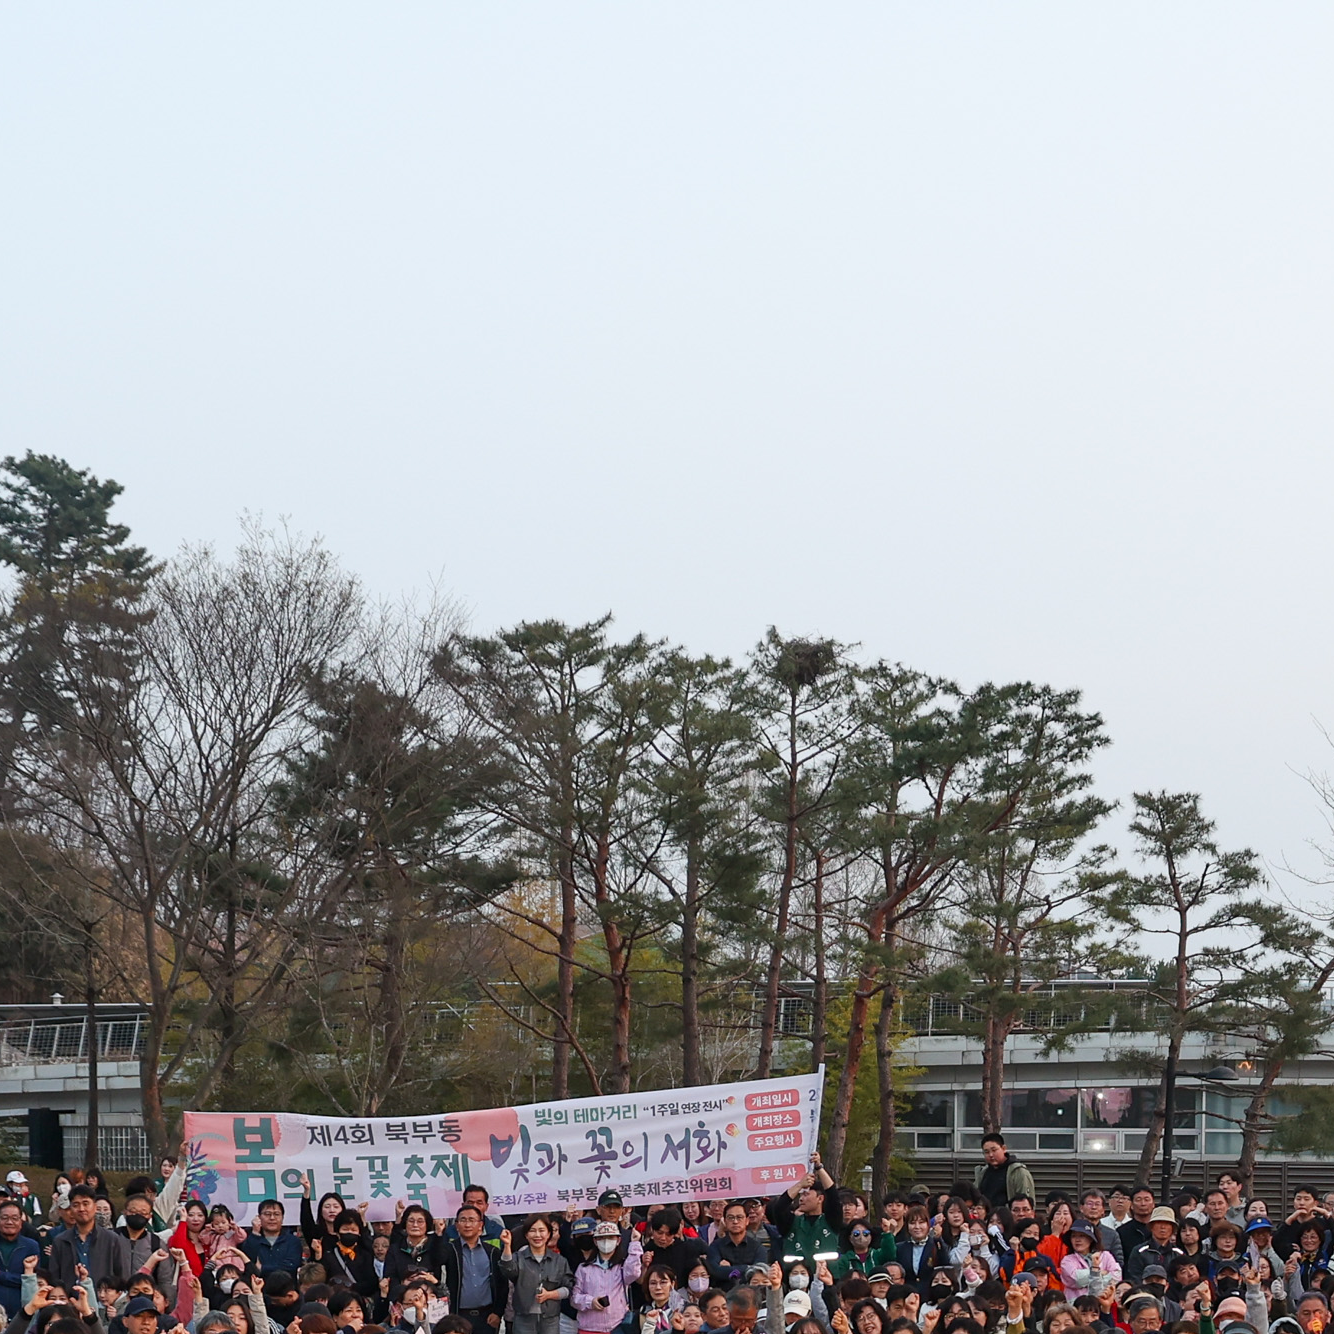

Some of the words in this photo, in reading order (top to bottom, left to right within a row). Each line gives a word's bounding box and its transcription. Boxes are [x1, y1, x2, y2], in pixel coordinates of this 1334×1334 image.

[751, 1093, 792, 1107] 개최일시
[534, 1108, 569, 1126] 빛의
[574, 1106, 638, 1124] 테마거리
[681, 1102, 702, 1115] 연장
[752, 1113, 793, 1127] 개최장소
[306, 1123, 375, 1147] 제4회
[385, 1119, 463, 1144] 북부동
[754, 1133, 794, 1148] 주요행사
[489, 1124, 568, 1190] 빛과
[578, 1126, 649, 1184] 꽃의
[660, 1121, 729, 1171] 서화
[492, 1192, 548, 1207] 주최/주관
[557, 1187, 599, 1202] 북부동
